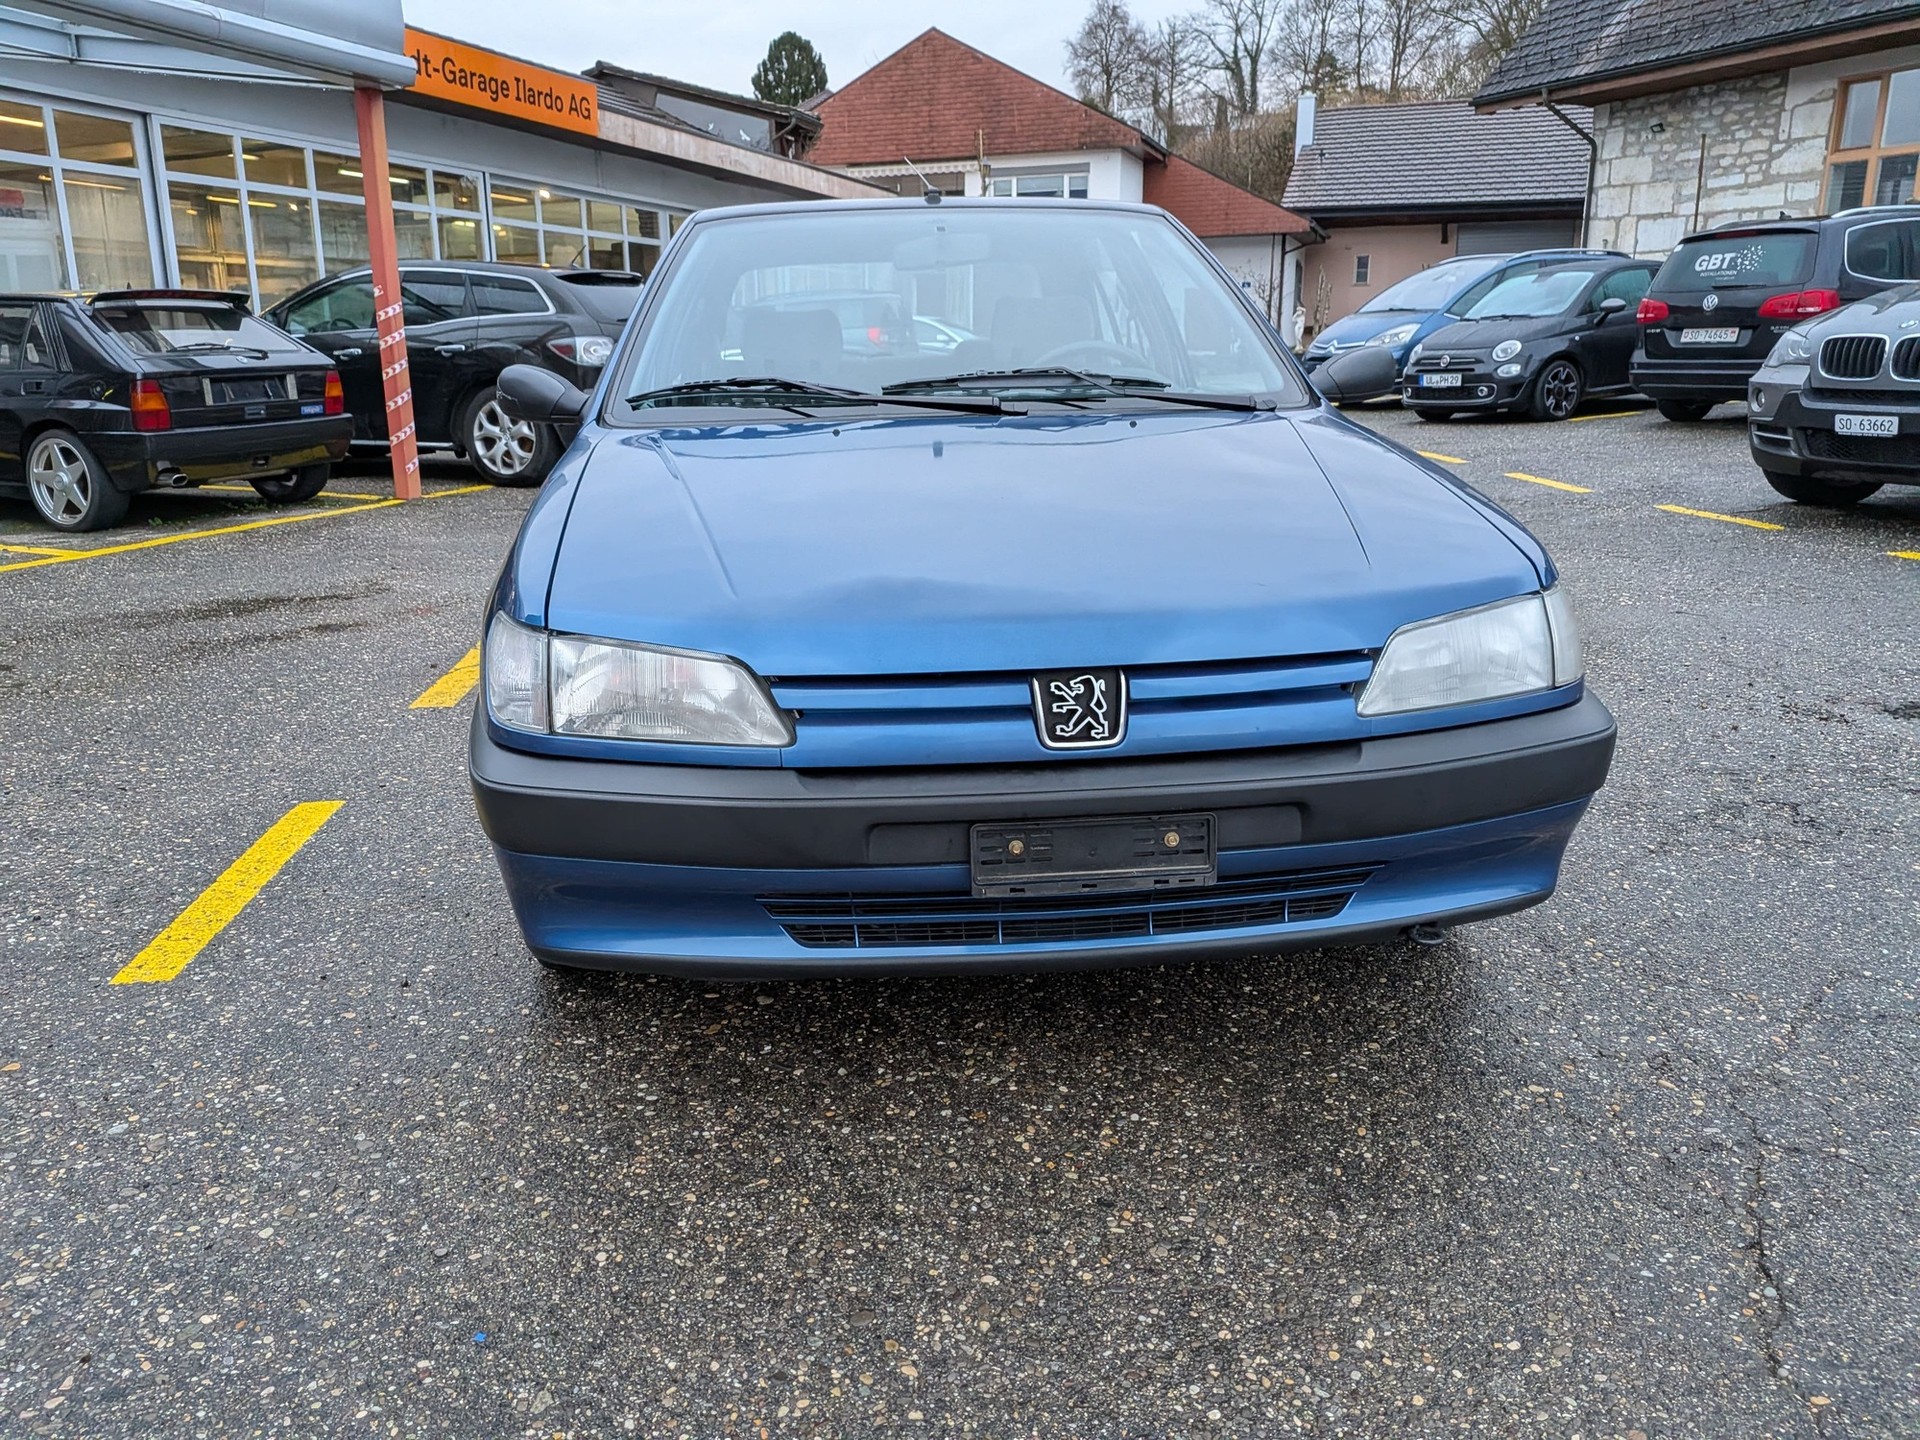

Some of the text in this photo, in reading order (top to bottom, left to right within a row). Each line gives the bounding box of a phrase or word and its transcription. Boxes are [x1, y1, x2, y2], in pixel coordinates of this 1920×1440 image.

[403, 48, 592, 120] dt-Garage Ilardo AG
[1694, 252, 1738, 271] GBT
